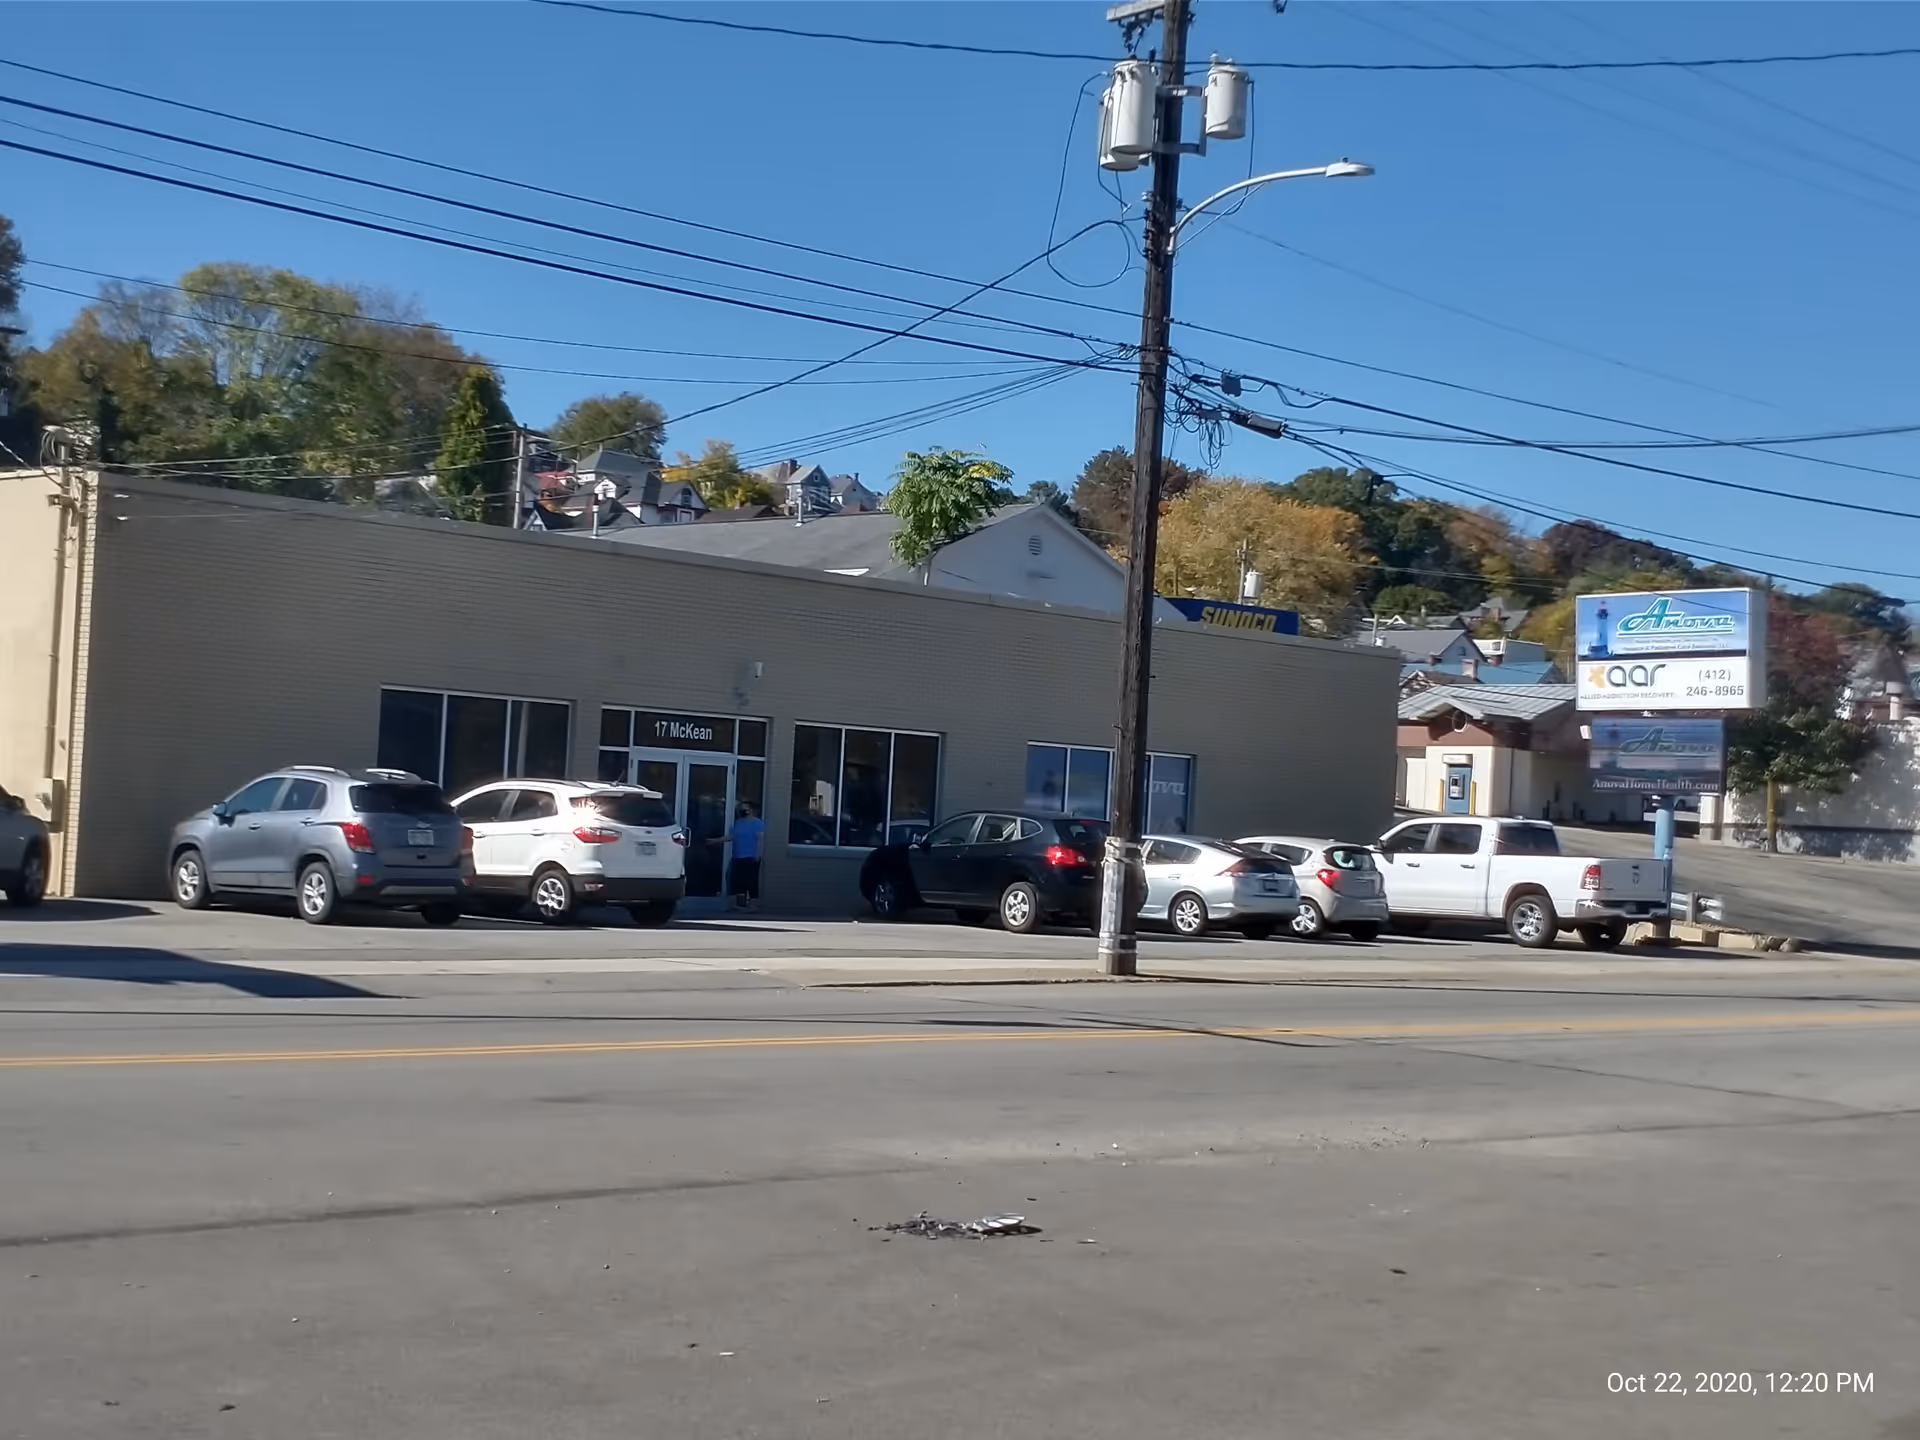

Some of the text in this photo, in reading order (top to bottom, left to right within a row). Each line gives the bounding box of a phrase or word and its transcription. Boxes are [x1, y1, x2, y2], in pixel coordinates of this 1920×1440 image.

[1200, 606, 1278, 632] SUNOCO
[1617, 597, 1735, 632] Anova
[1698, 669, 1732, 681] (412)
[1686, 685, 1744, 697] 246-8965
[655, 721, 712, 740] 17 McKean
[1592, 779, 1719, 791] AnovaHomeHealth.com
